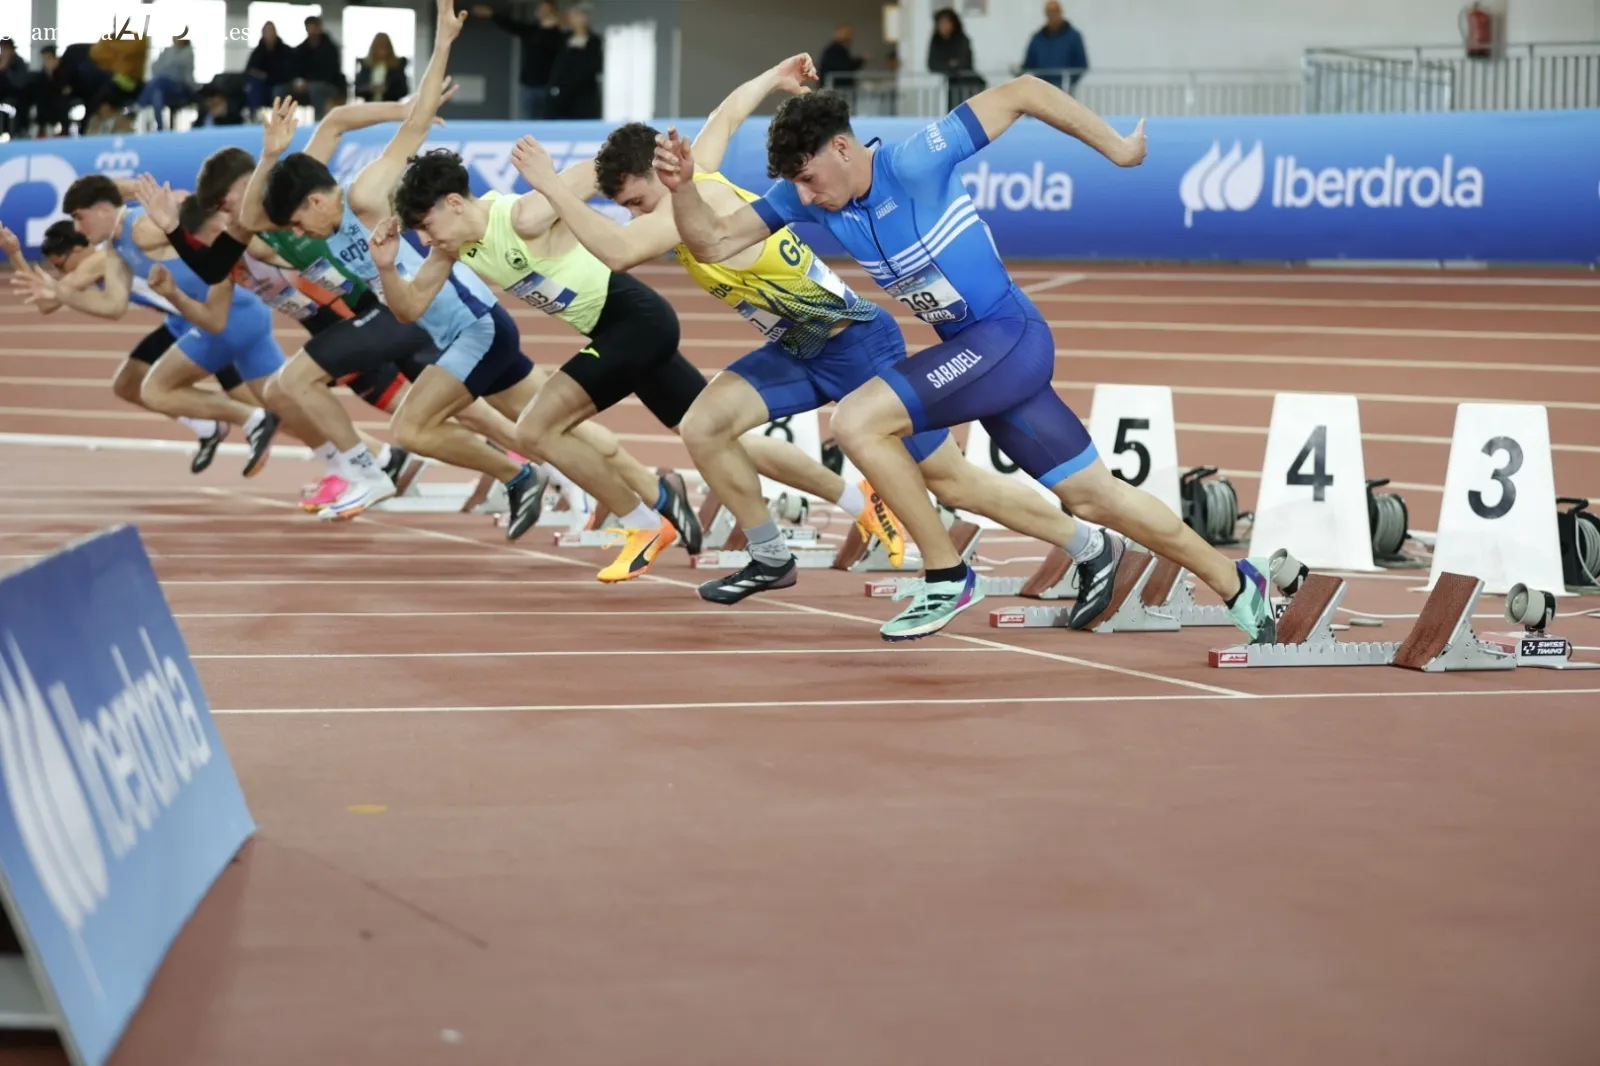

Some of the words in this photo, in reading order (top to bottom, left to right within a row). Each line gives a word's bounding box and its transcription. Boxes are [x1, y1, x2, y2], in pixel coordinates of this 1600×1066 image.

[961, 159, 1073, 211] drola
[1272, 153, 1484, 208] Iberdrola
[900, 291, 939, 311] 269
[926, 348, 983, 389] SABADELL
[1111, 417, 1151, 487] 5
[1286, 425, 1334, 502] 4
[1467, 436, 1524, 519] 3
